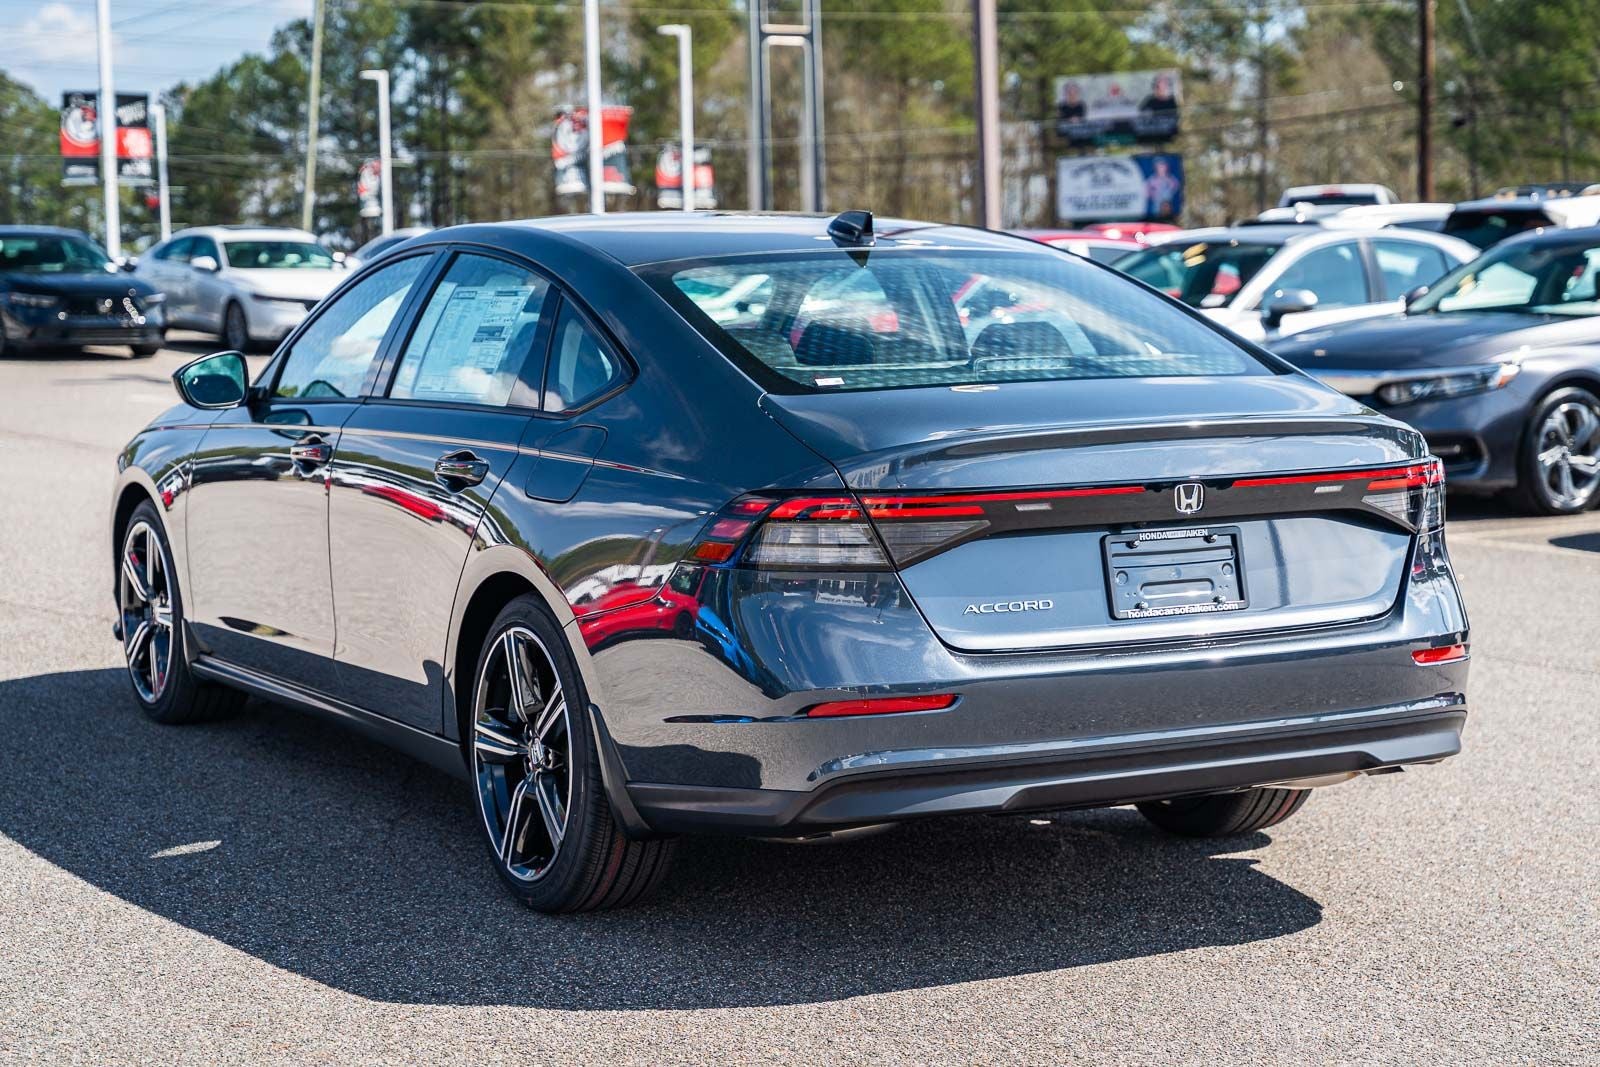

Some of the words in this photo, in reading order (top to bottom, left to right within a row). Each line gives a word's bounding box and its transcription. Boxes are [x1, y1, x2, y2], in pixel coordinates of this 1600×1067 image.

[1139, 531, 1168, 541] HONDA
[1186, 529, 1208, 537] AIKEN
[963, 599, 1054, 615] ACCORD
[1128, 603, 1238, 619] hondacarsofaiken.com
